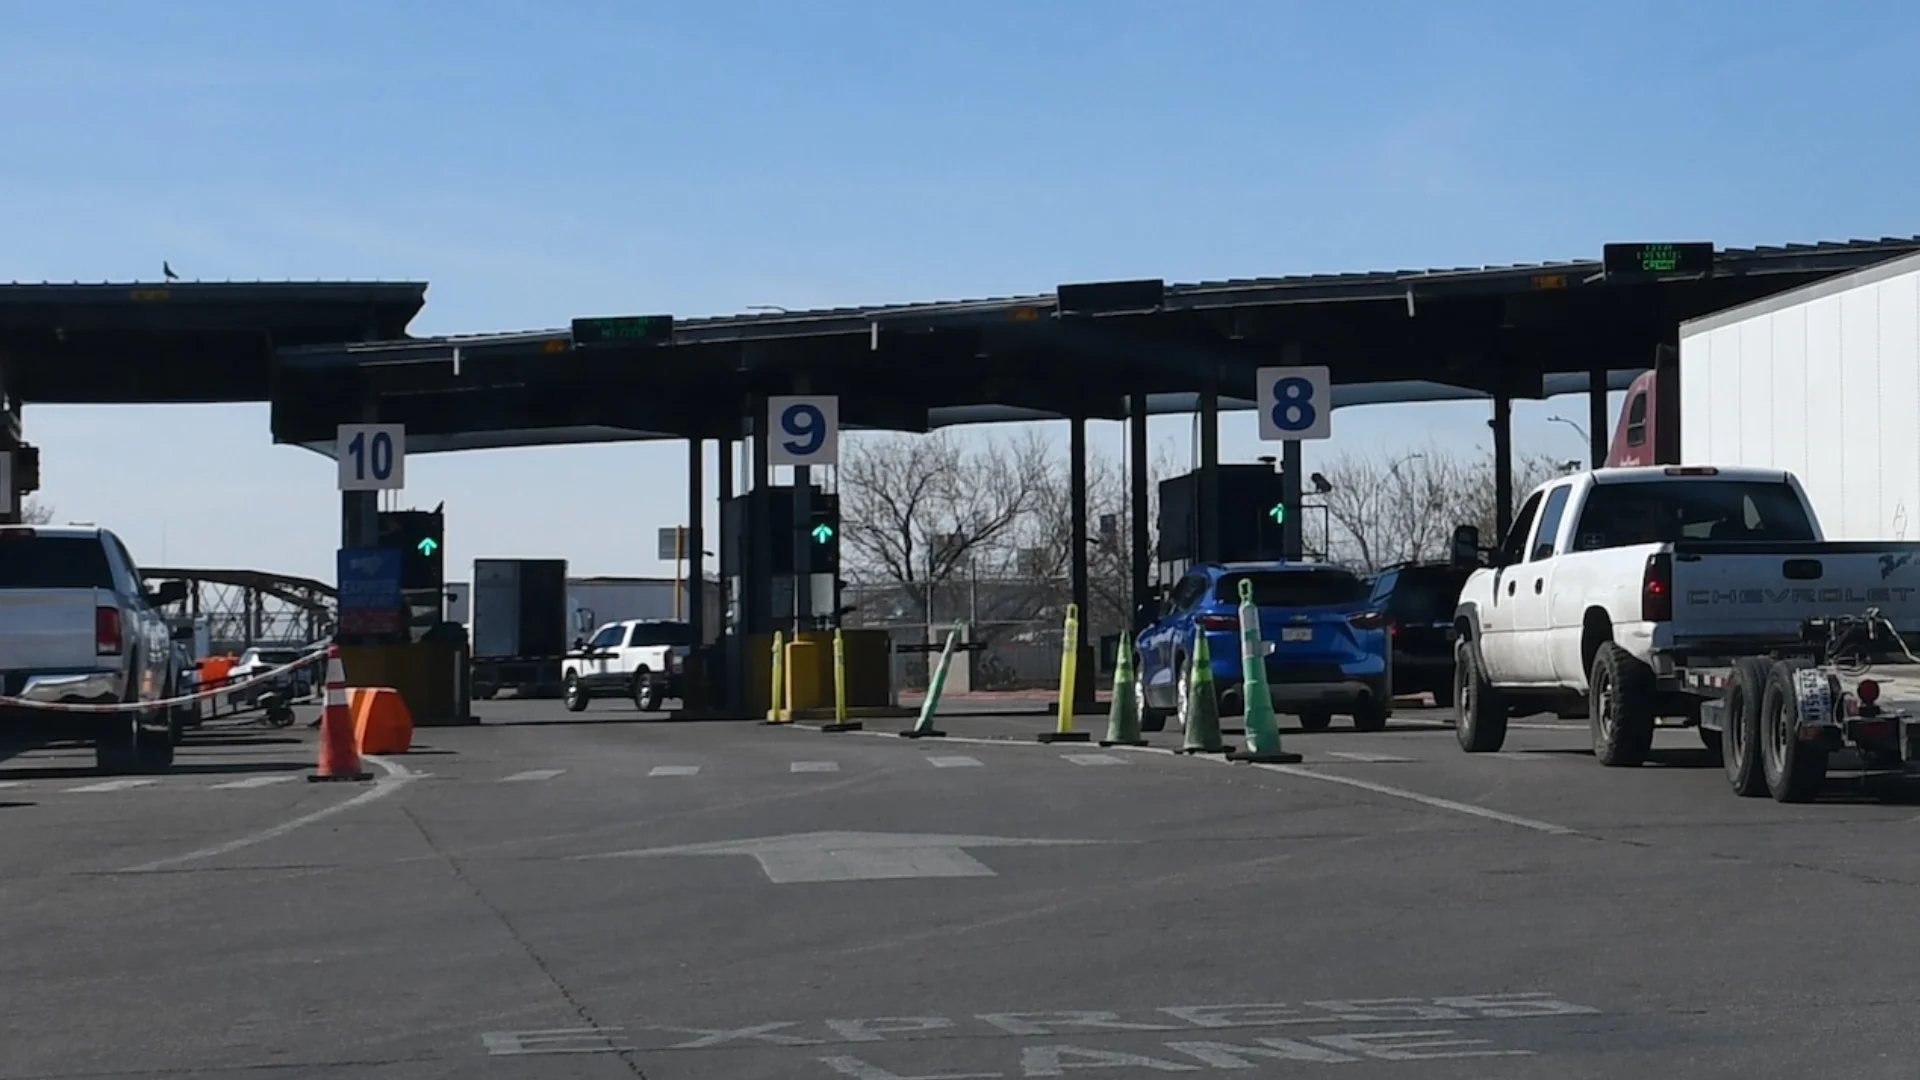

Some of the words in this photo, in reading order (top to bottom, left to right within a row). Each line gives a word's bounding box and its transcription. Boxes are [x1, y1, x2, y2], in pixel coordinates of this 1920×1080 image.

[1272, 377, 1316, 431] 8
[780, 404, 826, 456] 9
[348, 431, 393, 481] 10
[1686, 587, 1915, 605] CHEVROLET
[481, 991, 1602, 1056] EXPRESS
[818, 1029, 1538, 1080] LANE
